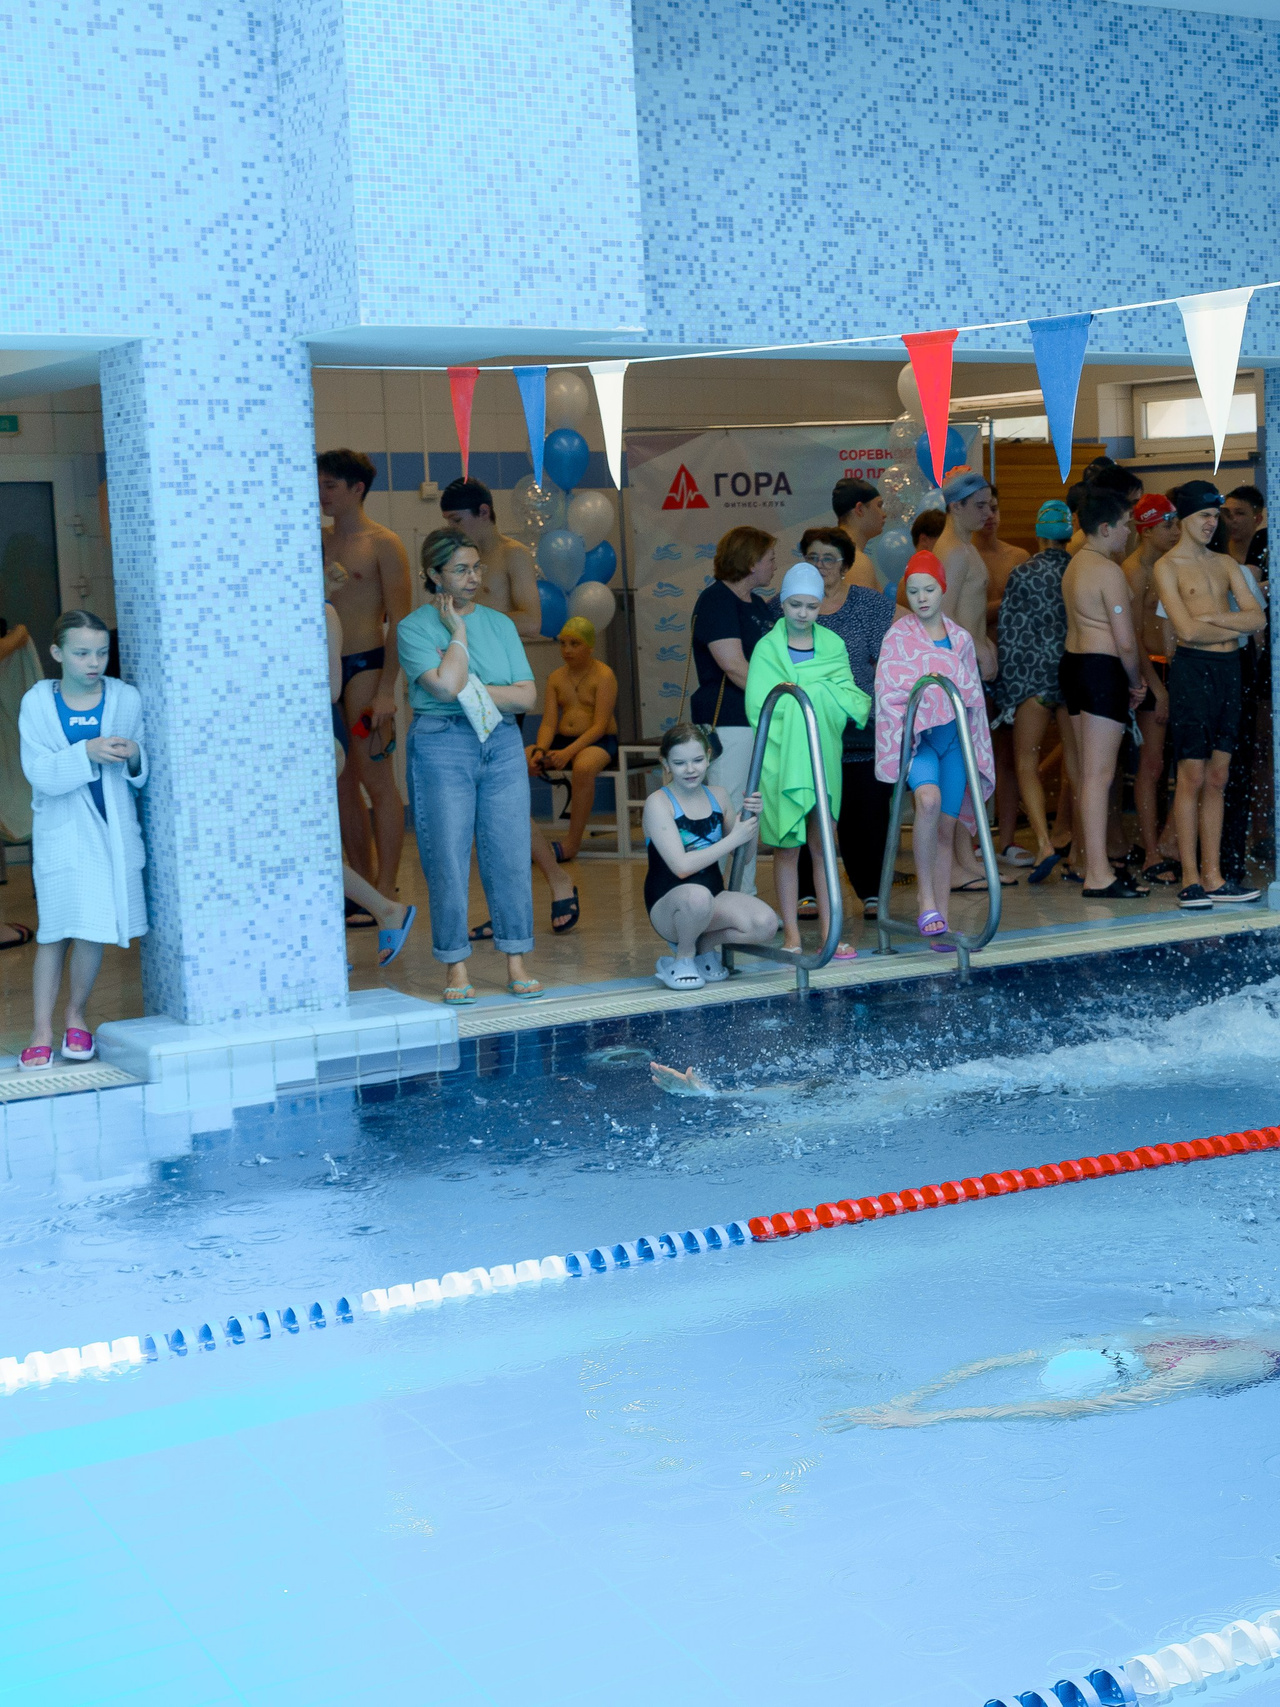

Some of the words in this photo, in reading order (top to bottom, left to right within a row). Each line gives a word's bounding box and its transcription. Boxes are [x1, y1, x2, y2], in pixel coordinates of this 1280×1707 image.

[838, 448, 908, 461] СОРЕВН
[844, 467, 864, 479] ПО
[714, 471, 793, 497] ГОРА
[724, 500, 786, 508] ФИТНЕС-КЛУБ
[69, 716, 99, 726] FILA
